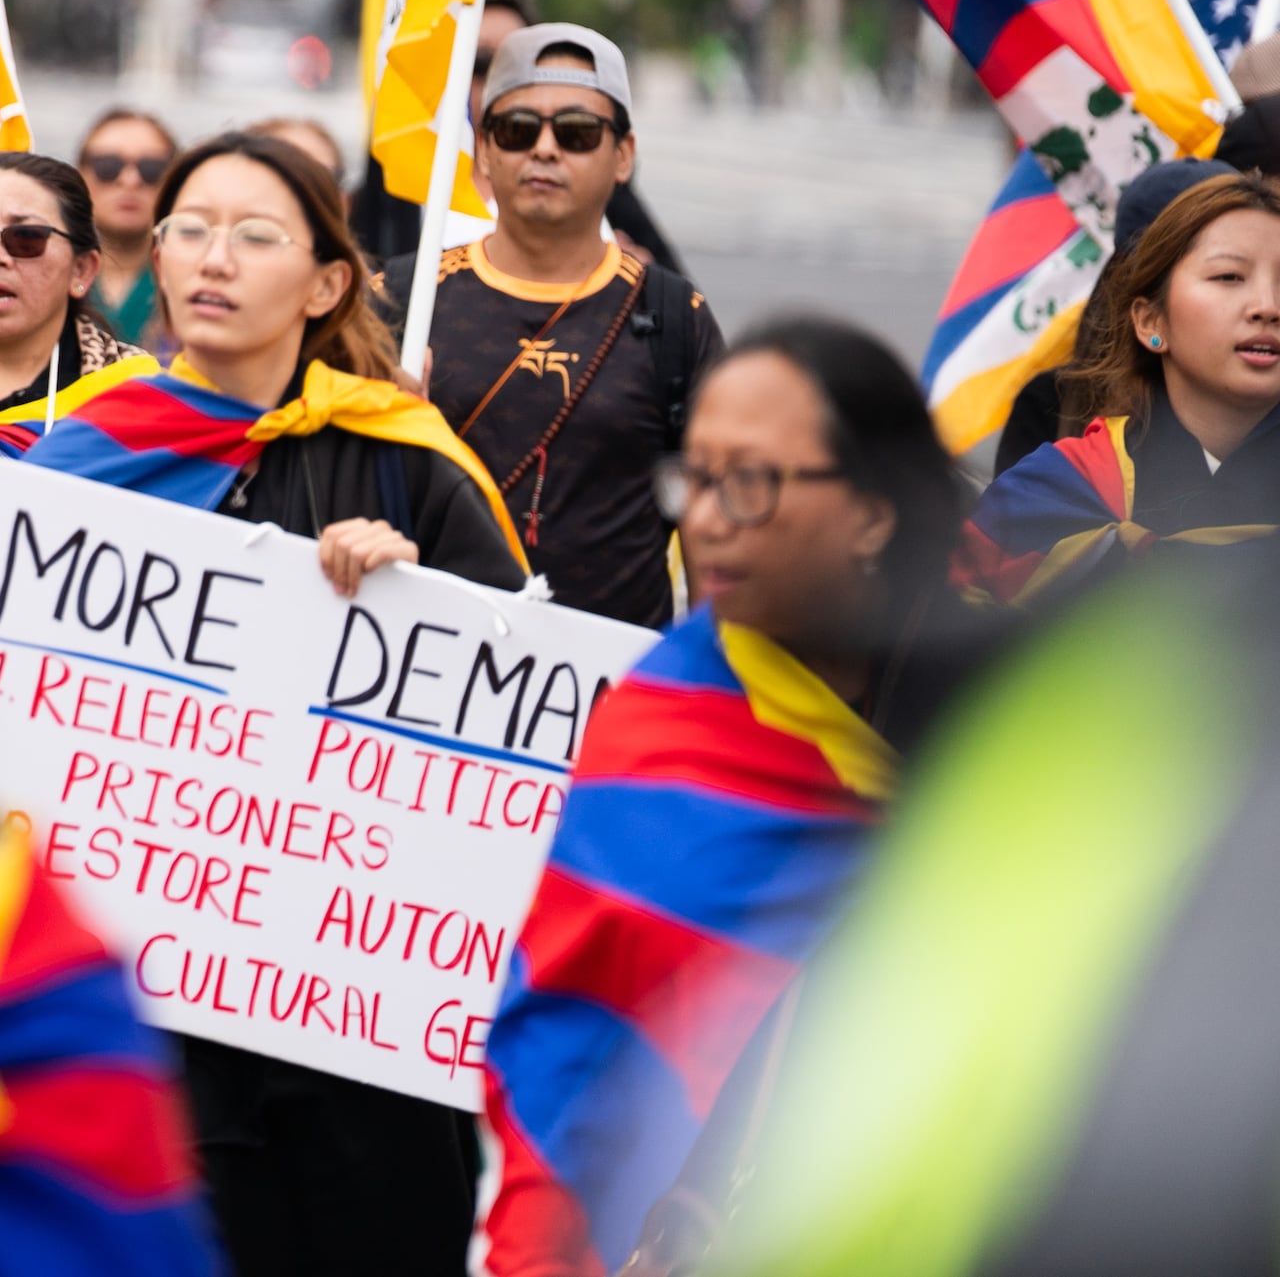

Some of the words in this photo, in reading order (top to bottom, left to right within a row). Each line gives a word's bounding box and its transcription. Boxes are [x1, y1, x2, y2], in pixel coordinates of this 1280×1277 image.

[28, 654, 274, 766] RELEASE
[307, 718, 568, 838] POLITICA
[326, 604, 609, 761] DEMA
[61, 751, 393, 871] PRISONERS
[136, 932, 400, 1052] CULTURAL
[423, 998, 496, 1081] GE
[315, 885, 506, 983] AUTON
